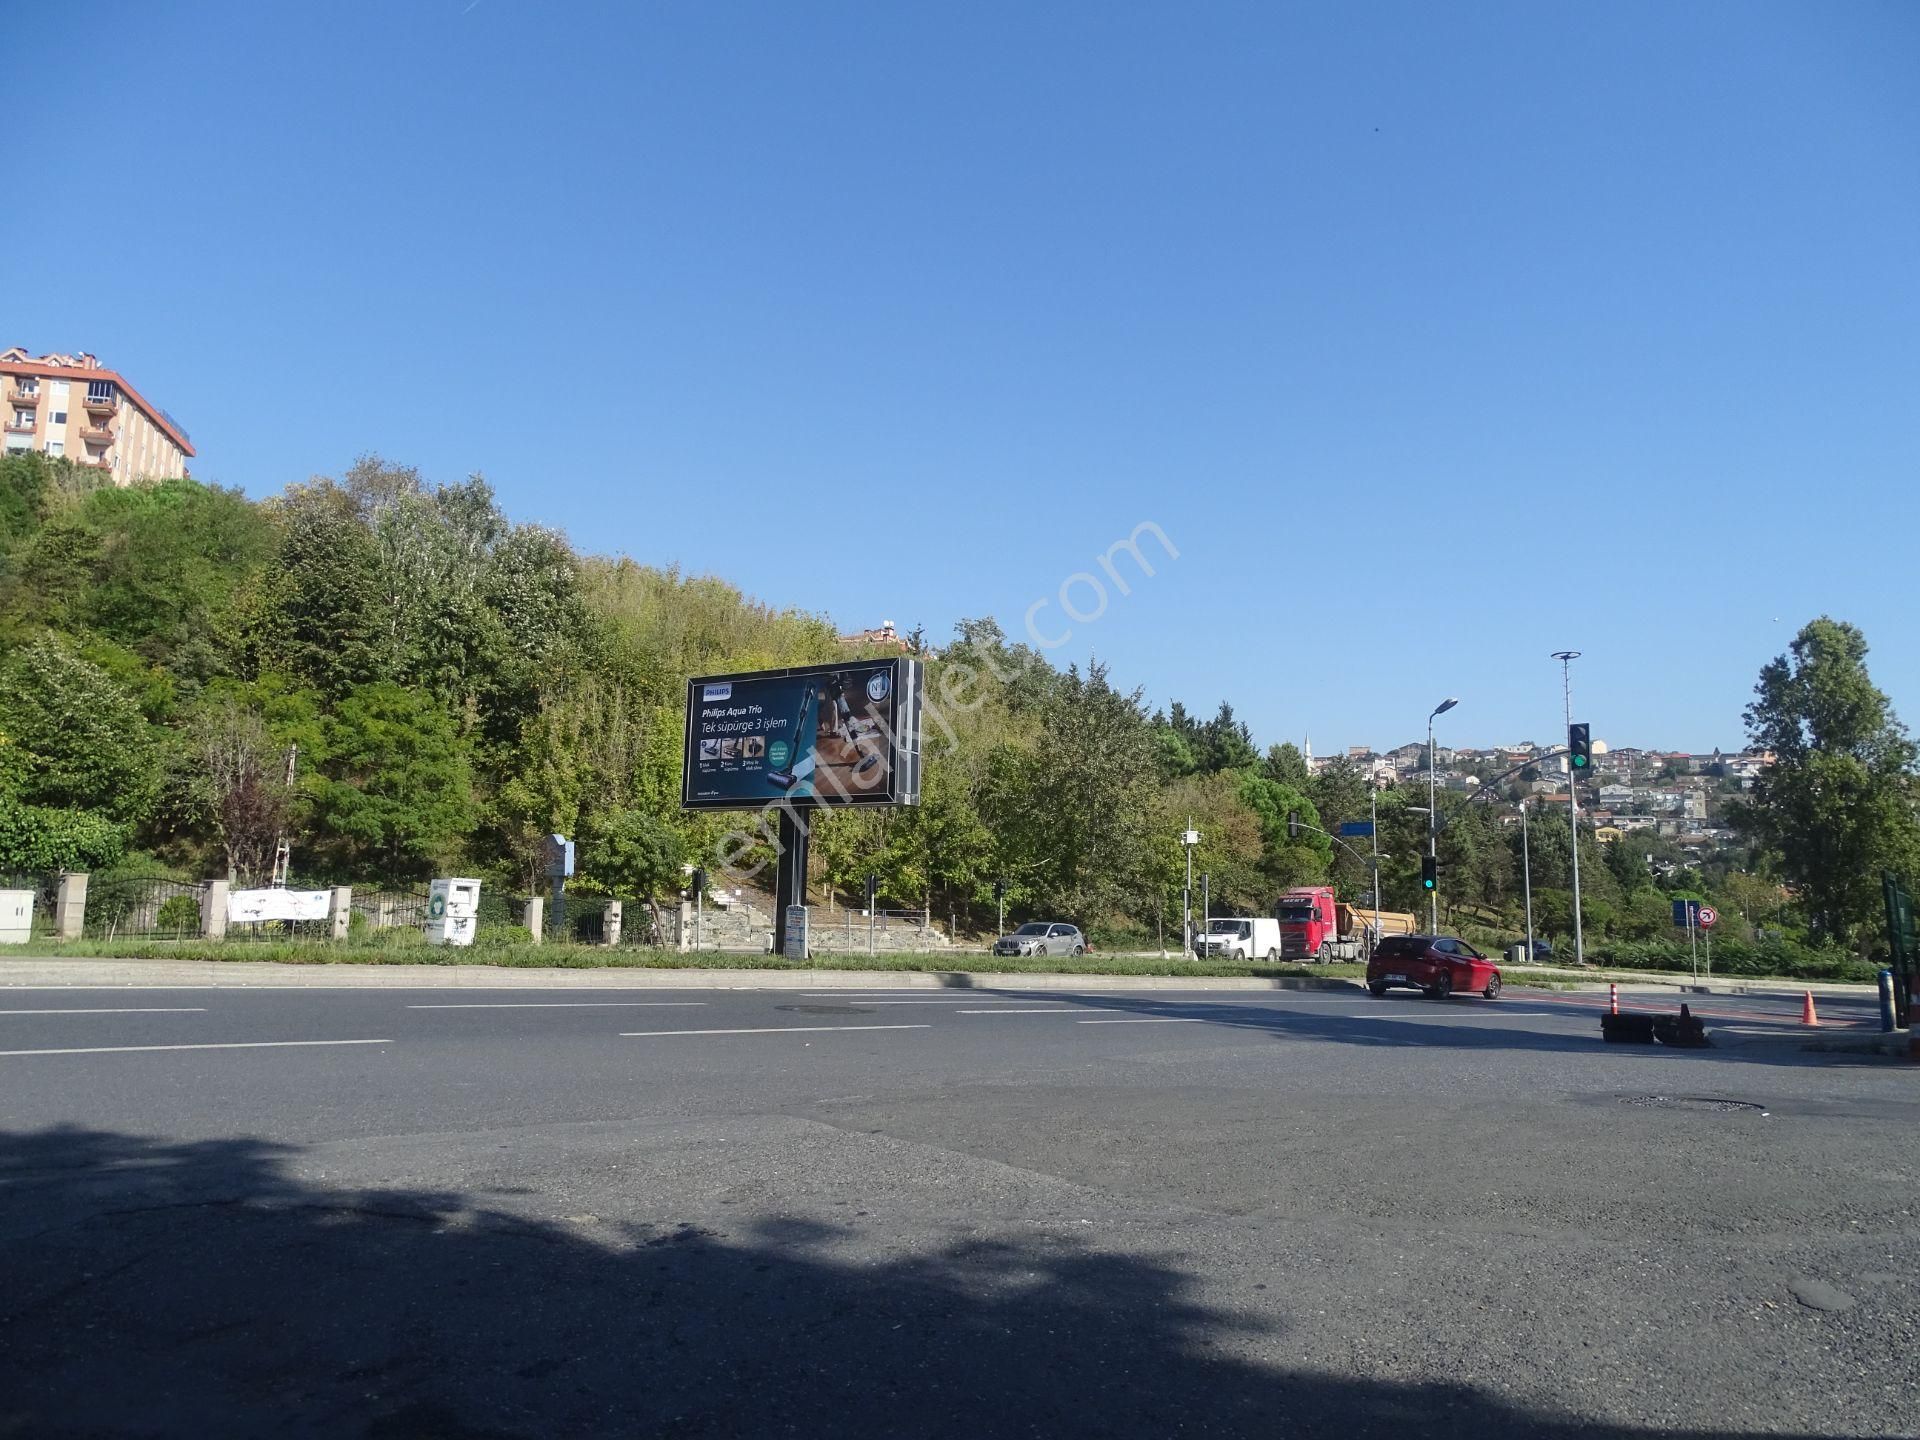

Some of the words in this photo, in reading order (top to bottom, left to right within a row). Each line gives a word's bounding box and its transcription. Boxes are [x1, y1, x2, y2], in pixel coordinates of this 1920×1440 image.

[705, 687, 729, 696] PHILIPS
[702, 708, 726, 718] Philips
[726, 707, 747, 717] Aqua
[748, 704, 762, 714] Trio
[702, 721, 717, 733] Tek
[717, 720, 754, 733] süpürge
[755, 718, 762, 730] 3
[763, 716, 788, 731] işlem
